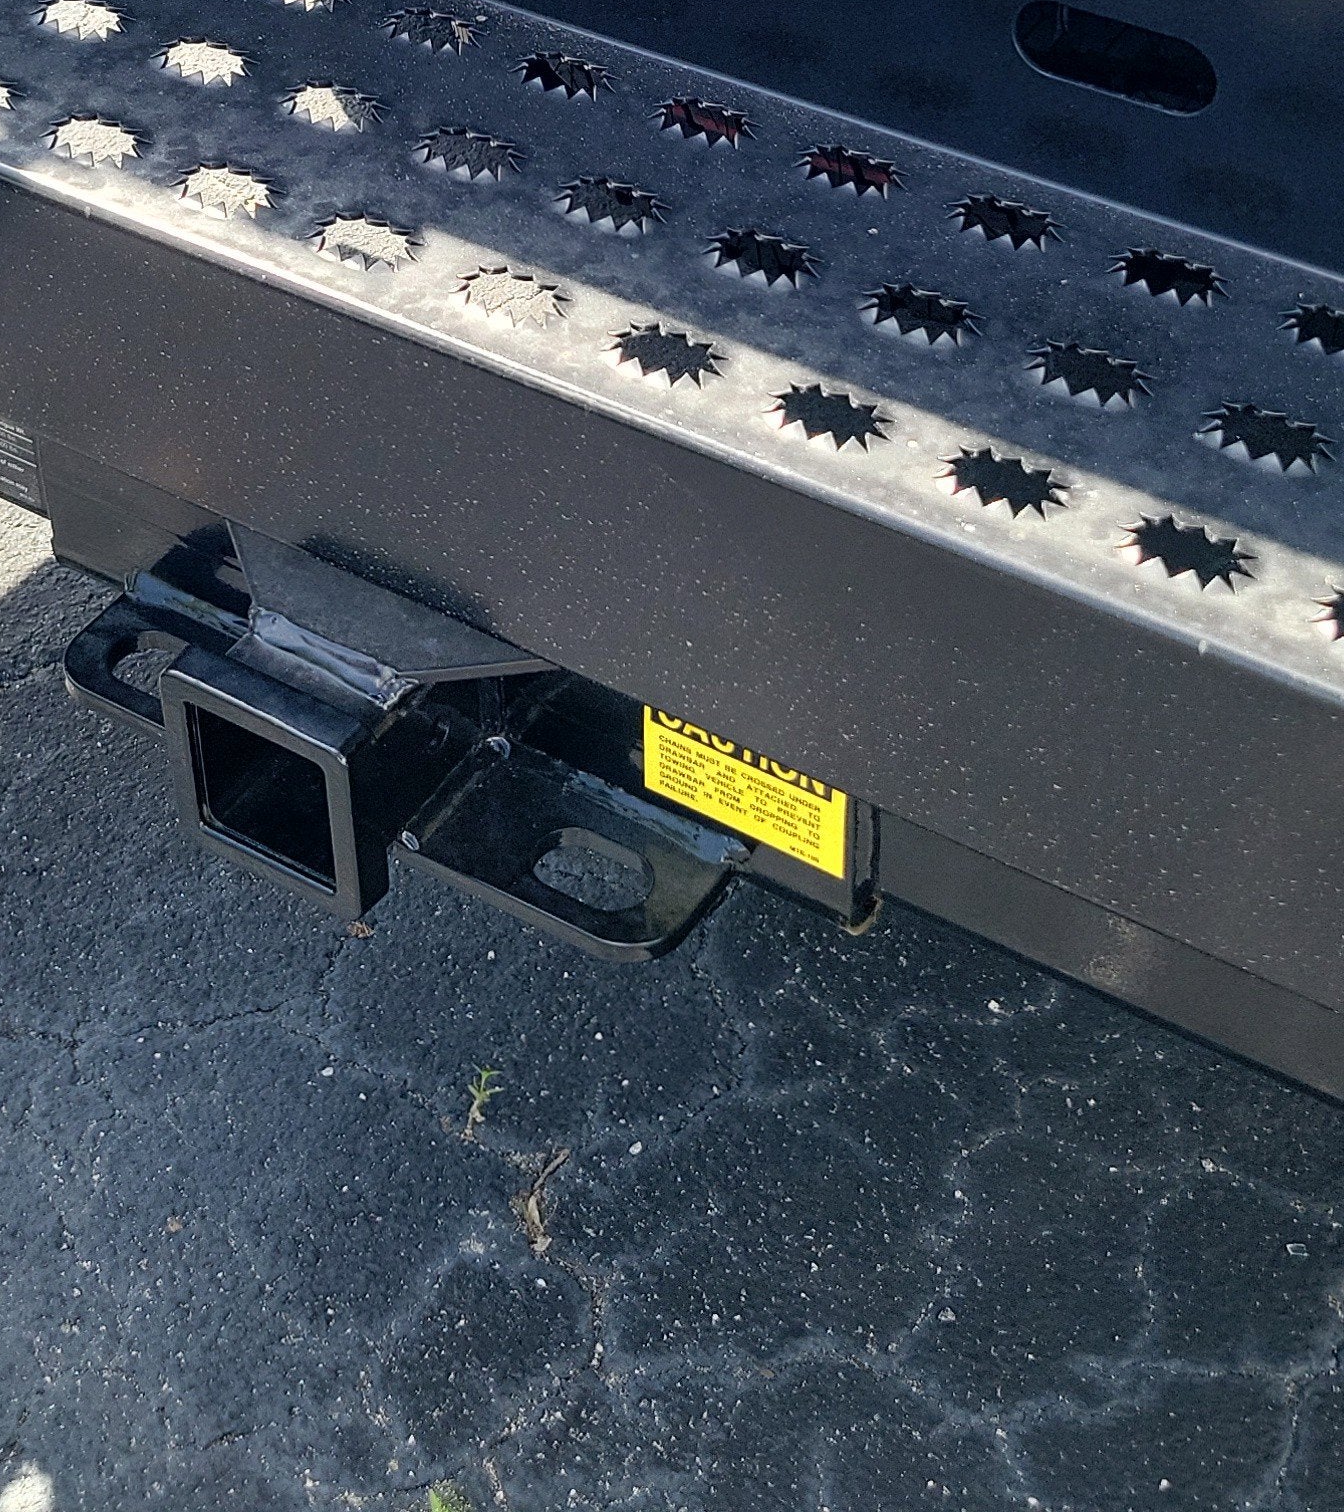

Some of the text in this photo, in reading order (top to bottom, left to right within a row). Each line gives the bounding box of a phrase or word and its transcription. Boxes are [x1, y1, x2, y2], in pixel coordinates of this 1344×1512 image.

[658, 734, 821, 813] CHAINS MUST BE CROSSED UNDER
[658, 743, 821, 822] DRAWBAR AND ATTACHED TO
[659, 761, 821, 840] DRAWBAR FROM DROPPING TO
[659, 770, 698, 793] GROUND
[718, 797, 748, 816] EVENT
[753, 814, 767, 823] OF
[772, 822, 820, 849] COUPLING
[660, 752, 821, 831] TOWING VEHICLE TO PREVENT
